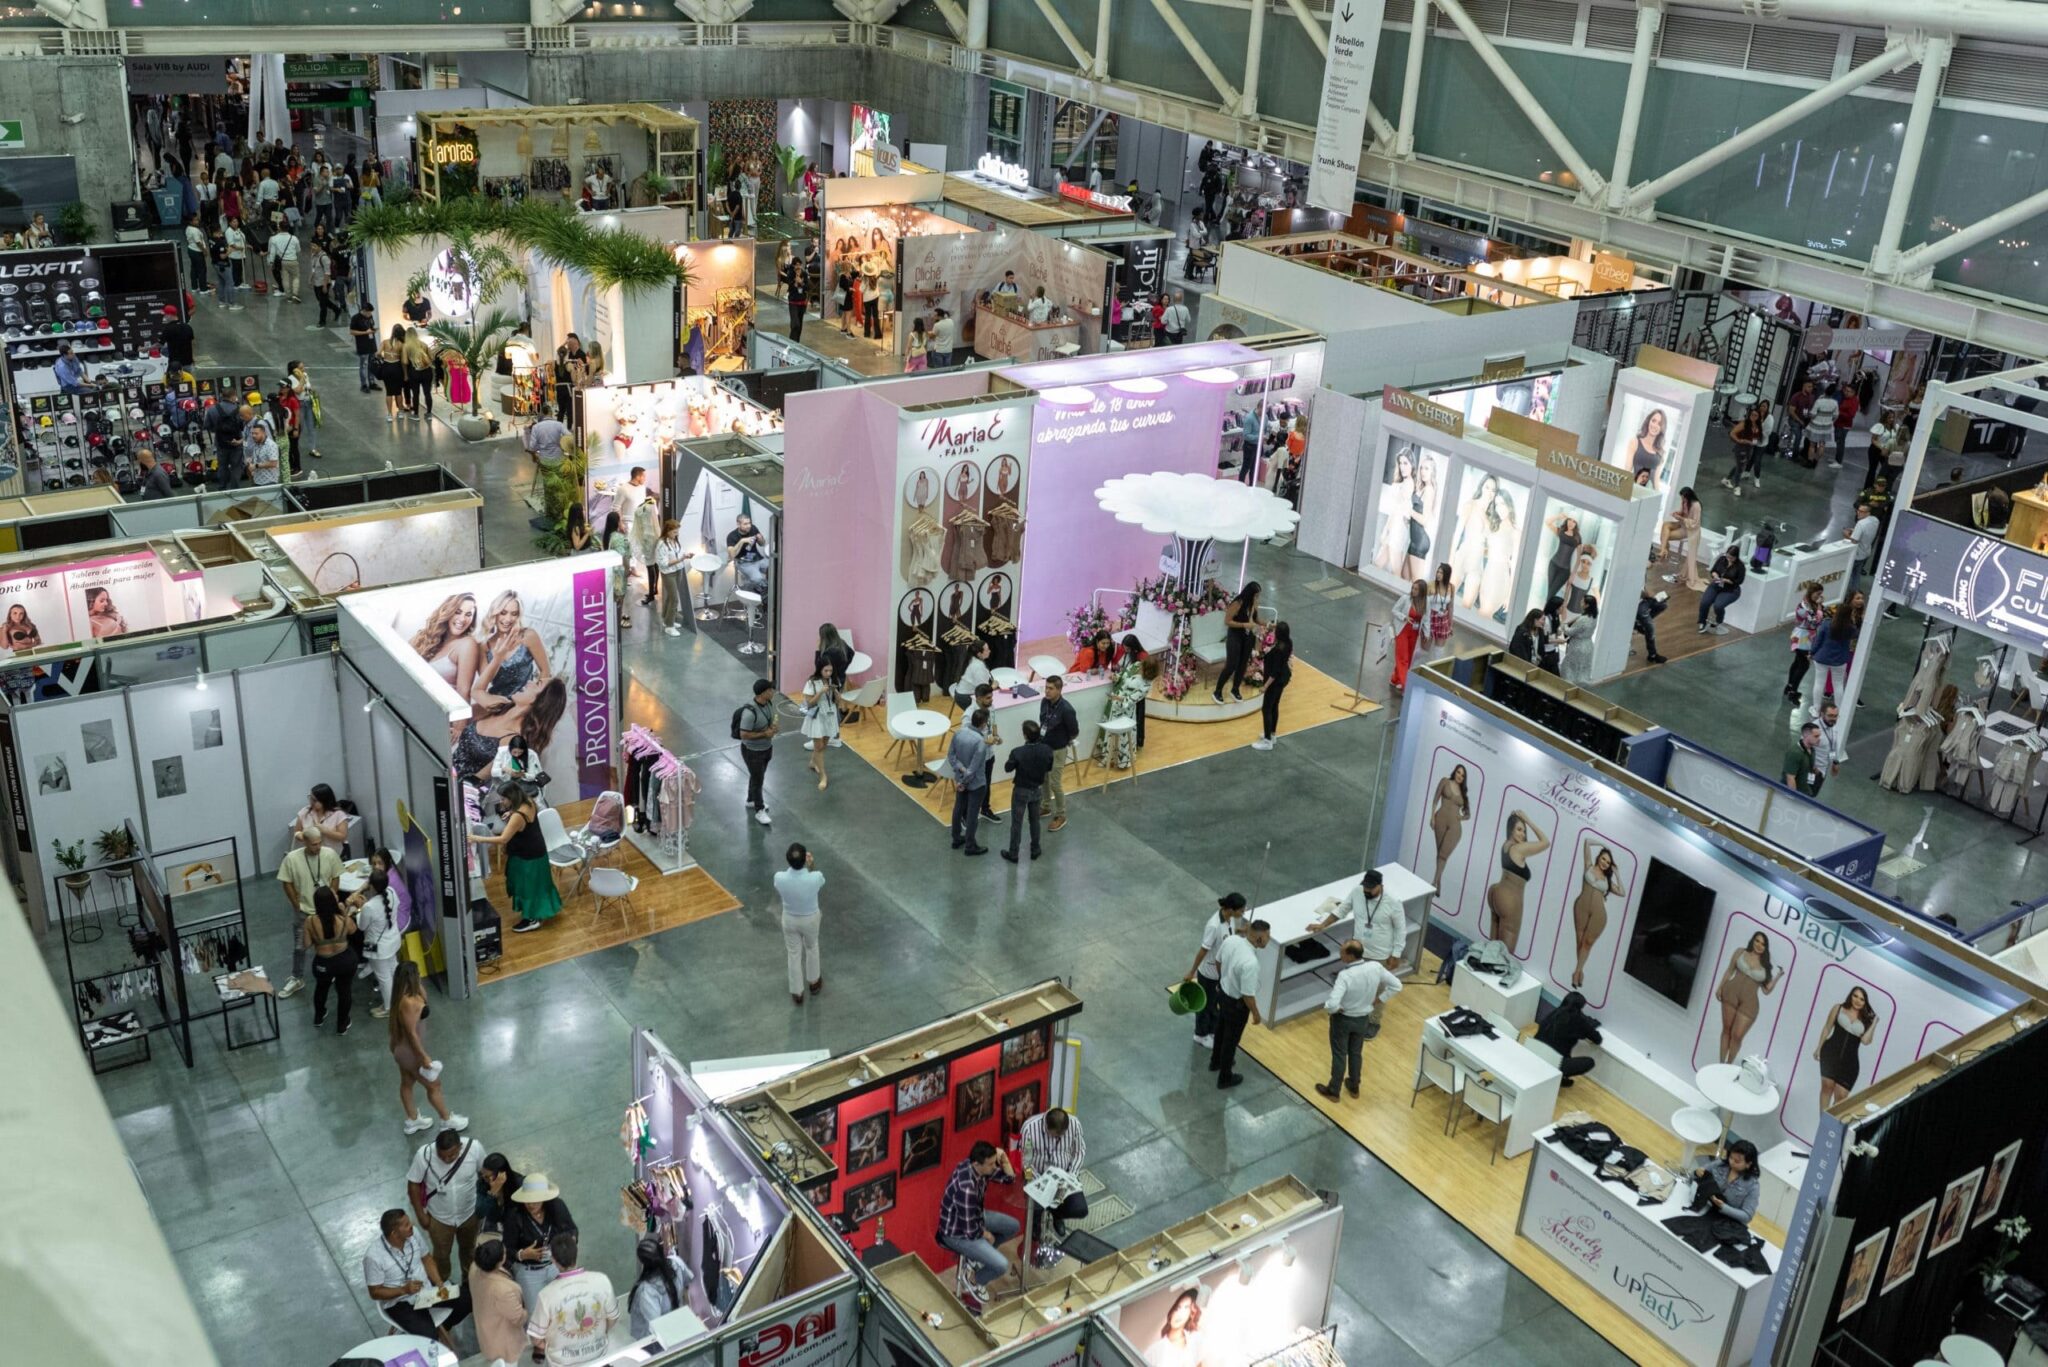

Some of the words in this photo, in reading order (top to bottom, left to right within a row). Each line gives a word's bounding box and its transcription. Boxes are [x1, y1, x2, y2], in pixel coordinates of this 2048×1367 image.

[1334, 45, 1353, 57] Verde
[1335, 34, 1365, 48] Pabellón
[131, 62, 152, 71] Sala
[173, 62, 184, 73] by
[187, 62, 210, 71] AUDI
[289, 63, 329, 73] SALIDA
[340, 65, 361, 75] EXIT
[1317, 154, 1335, 167] Trunk
[1337, 160, 1356, 172] Shows
[914, 266, 943, 283] Cliché
[990, 331, 1012, 356] Cliché
[1110, 397, 1123, 413] 18
[1389, 392, 1414, 411] ANN
[1416, 402, 1459, 427] CHERY
[1037, 418, 1107, 444] abrazando
[1110, 417, 1130, 433] tus
[1132, 410, 1174, 430] curvas
[945, 445, 975, 457] FAJAS
[1547, 448, 1579, 473] ANN
[1578, 460, 1625, 488] CHERY
[1969, 536, 1990, 562] SLIM
[70, 577, 111, 591] Abdominal
[112, 575, 132, 587] para
[133, 571, 156, 584] mujer
[71, 569, 100, 580] Tablero
[102, 567, 112, 576] de
[26, 578, 48, 591] bra
[579, 590, 607, 768] PROVÓCAME
[1545, 783, 1600, 819] Marcel
[1560, 773, 1601, 810] Lady
[1545, 1221, 1602, 1265] Marcel
[1562, 1215, 1603, 1256] Lady
